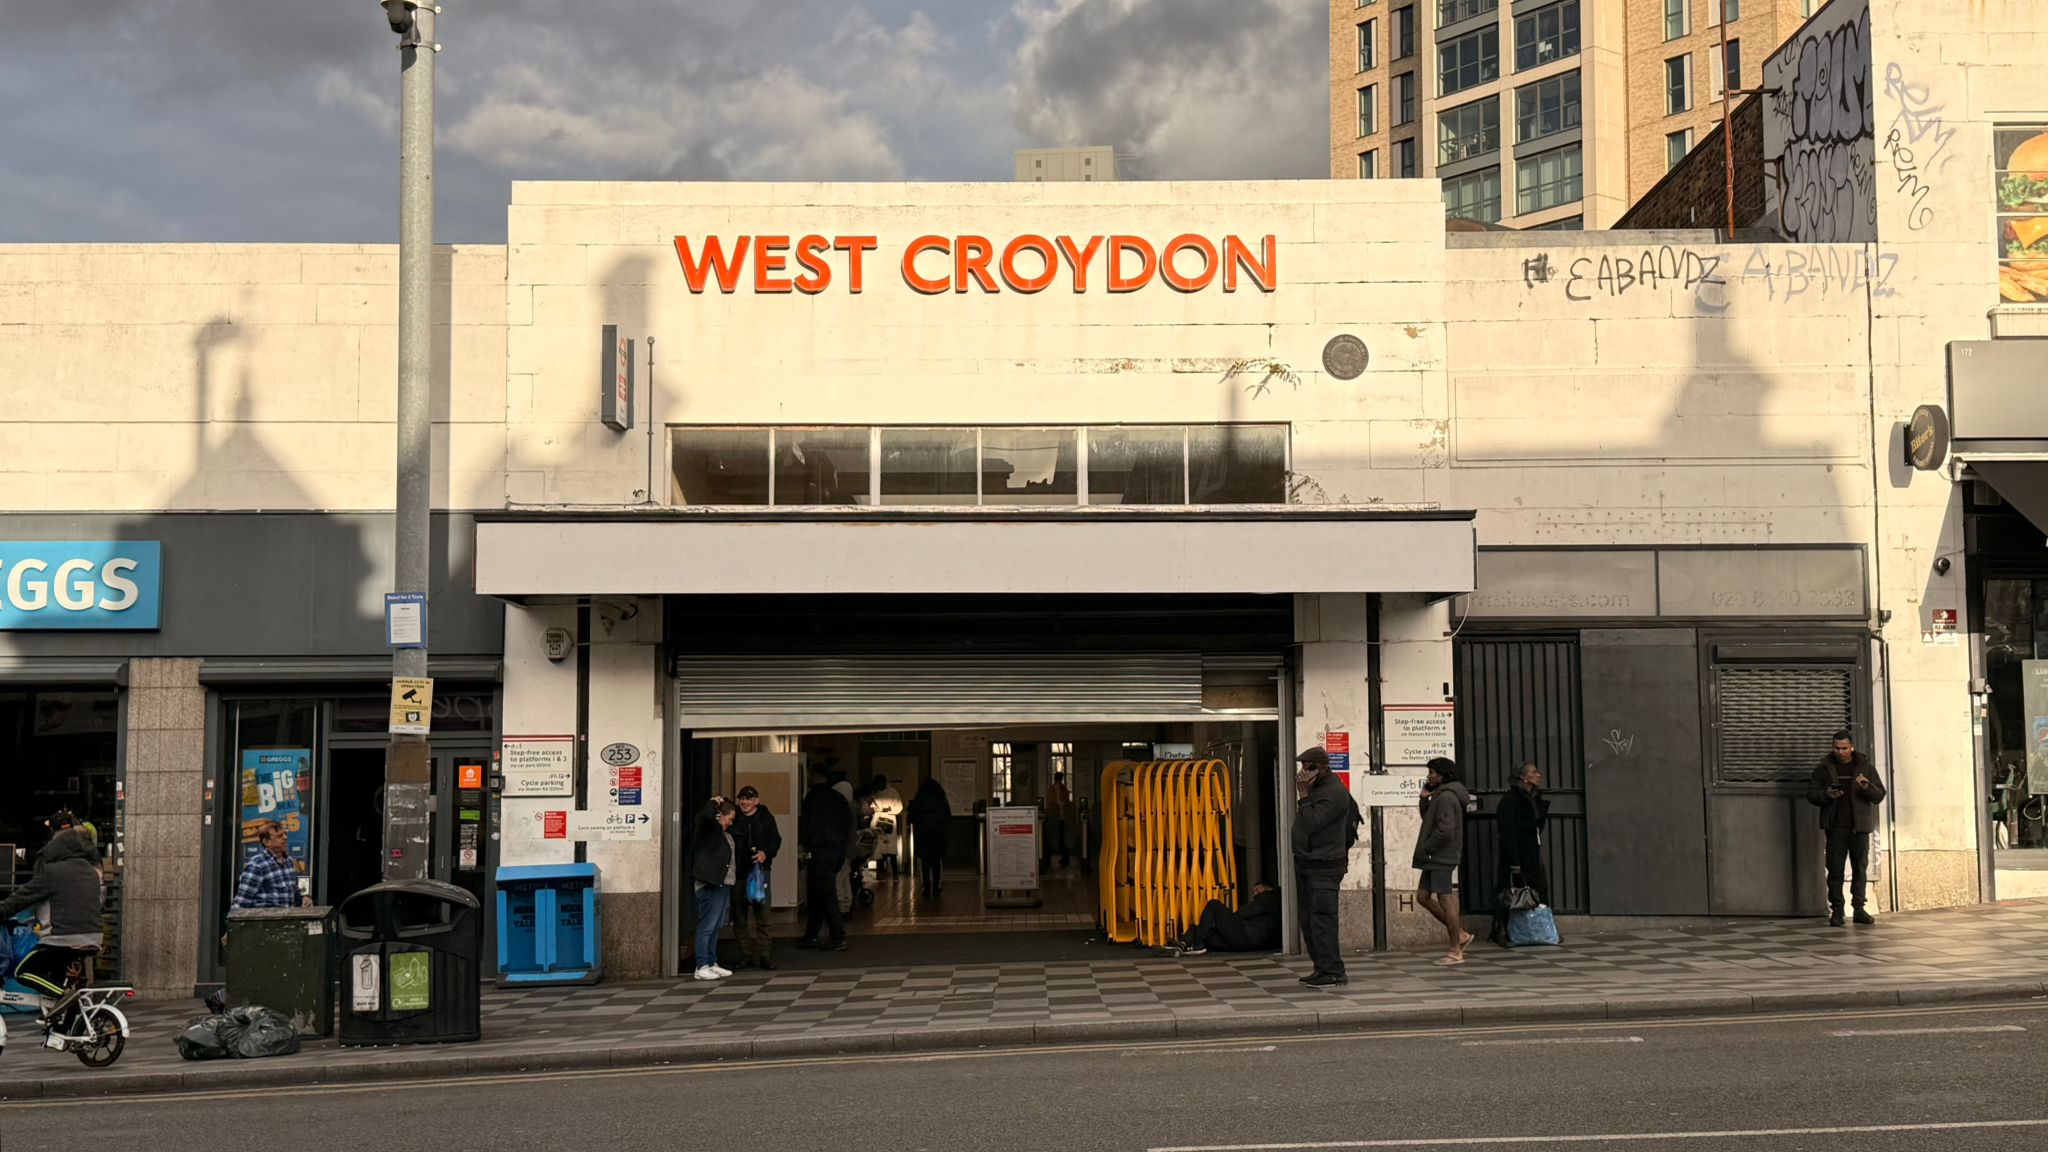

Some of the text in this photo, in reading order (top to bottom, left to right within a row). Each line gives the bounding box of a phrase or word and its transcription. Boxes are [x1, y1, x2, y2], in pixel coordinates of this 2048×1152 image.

[674, 232, 1278, 296] WEST CROYDON
[0, 557, 140, 612] GGS
[608, 748, 632, 761] 253
[1423, 748, 1447, 756] parking
[540, 779, 565, 787] parking
[1399, 893, 1414, 912] H
